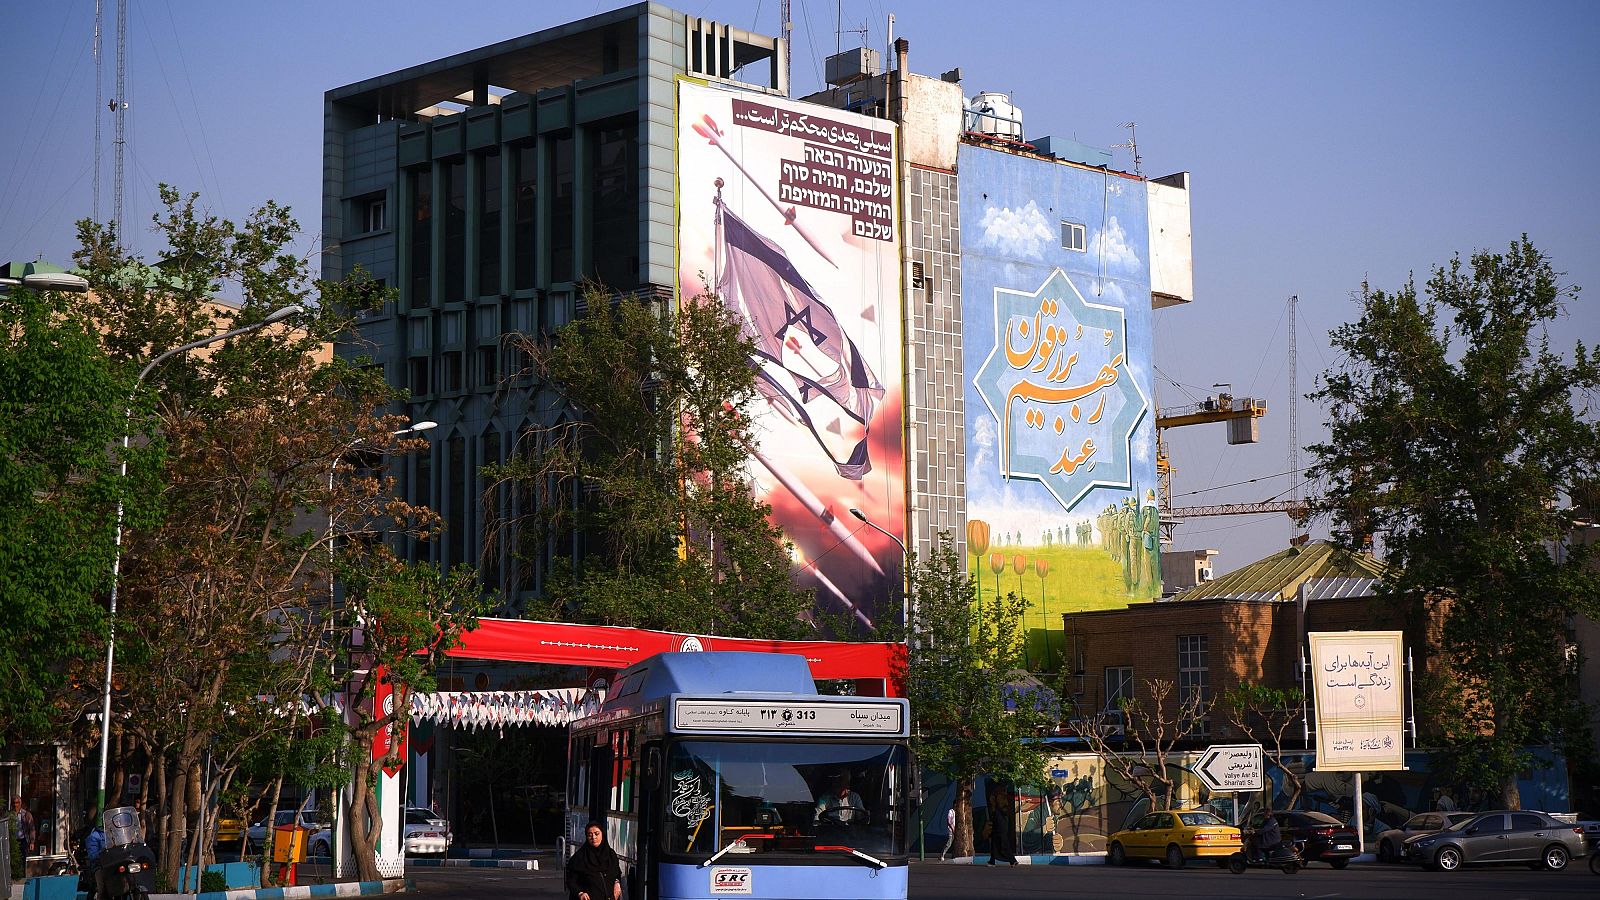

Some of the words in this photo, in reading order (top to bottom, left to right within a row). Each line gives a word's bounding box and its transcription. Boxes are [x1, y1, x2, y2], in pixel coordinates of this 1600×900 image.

[827, 125, 860, 149] بعدی
[859, 130, 891, 153] سیلی
[804, 145, 844, 169] הבאה
[783, 162, 810, 184] סוף
[847, 155, 891, 179] הטעות
[812, 168, 848, 190] תהיה
[850, 177, 891, 198] שלכם,
[780, 183, 841, 210] המזויפת
[843, 196, 892, 220] המדינה
[854, 218, 892, 240] שלכם
[1325, 655, 1348, 673] برای
[1373, 654, 1390, 671] این
[1326, 673, 1357, 688] است
[1358, 673, 1391, 690] زندگی
[718, 708, 734, 717] کاوه
[736, 708, 750, 717] پایانه
[760, 709, 777, 720] ۳۱۳
[796, 710, 816, 720] 313
[850, 709, 869, 723] سپاه
[870, 711, 891, 722] میدان
[1229, 750, 1252, 759] ولیعصر
[1227, 761, 1253, 771] شریعتی
[718, 874, 748, 882] SRC
